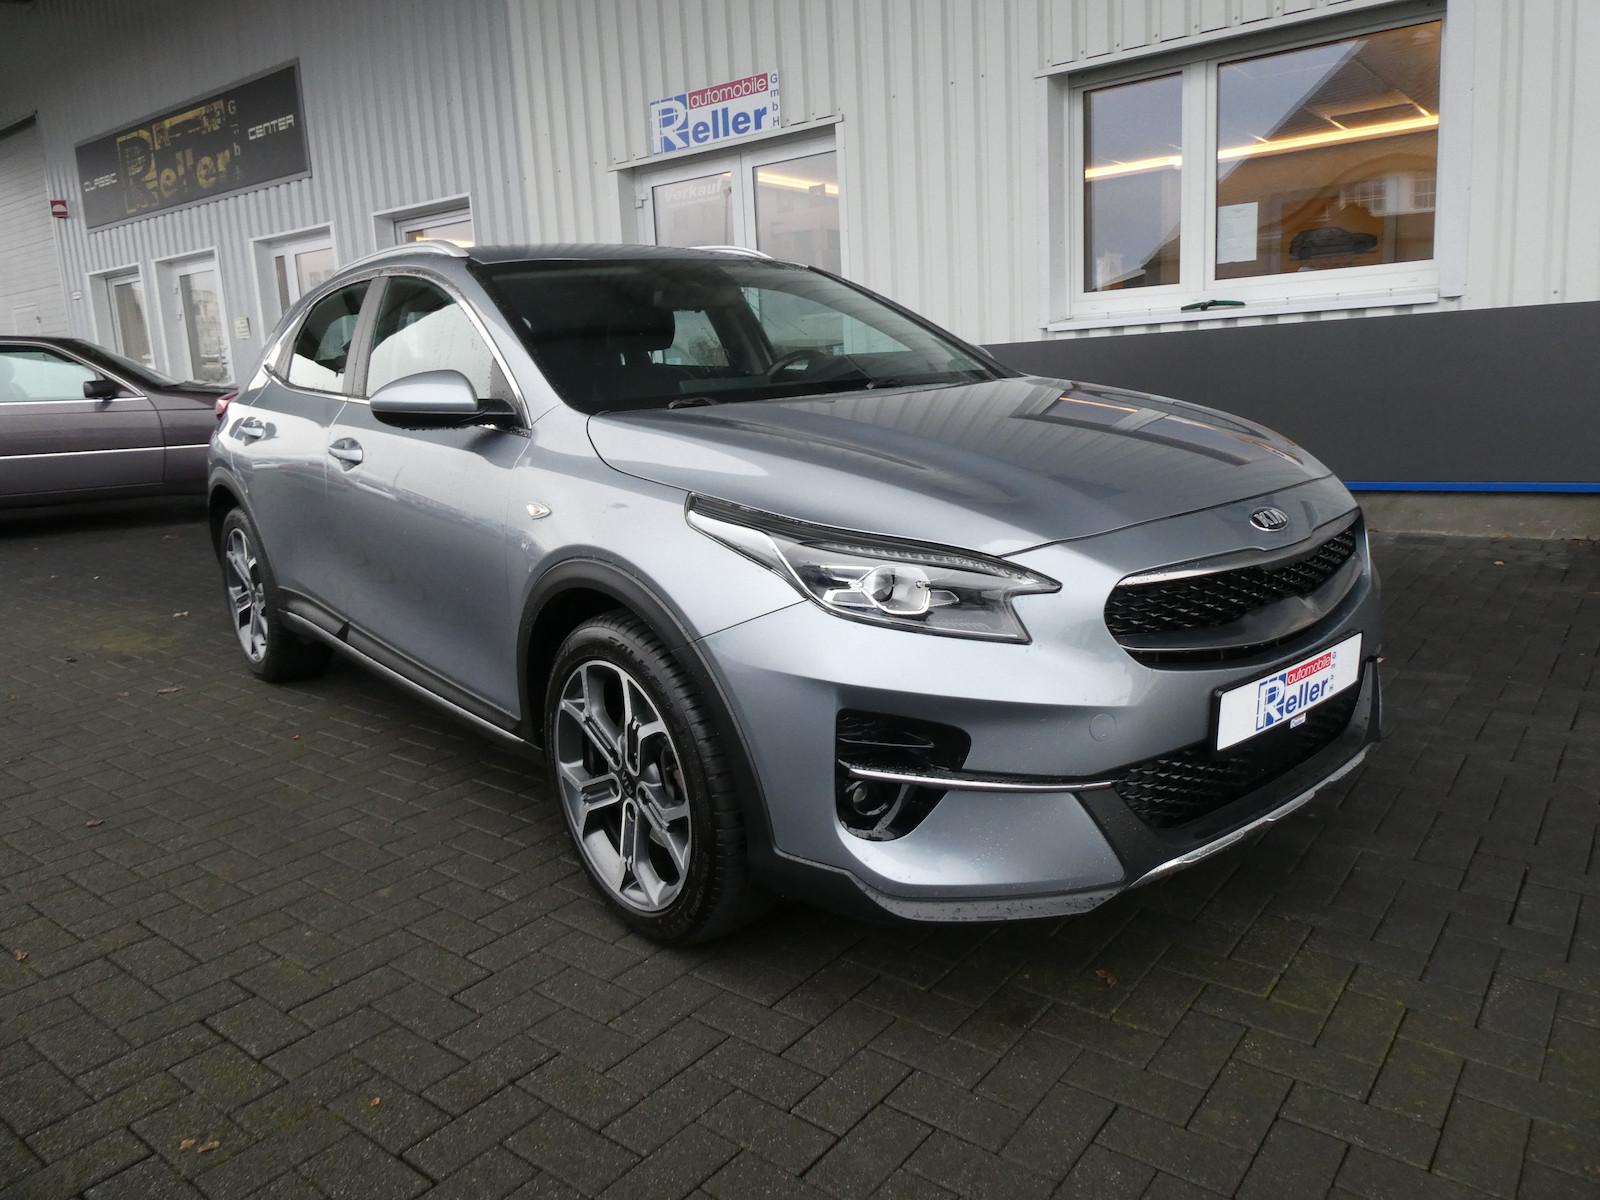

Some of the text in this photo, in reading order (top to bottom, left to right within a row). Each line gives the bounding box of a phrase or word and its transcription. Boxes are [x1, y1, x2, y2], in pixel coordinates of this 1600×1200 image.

[690, 76, 767, 108] automobile
[247, 114, 295, 140] CENTER
[650, 98, 768, 154] Reller
[1253, 510, 1287, 527] KIA
[1287, 654, 1332, 685] automobile
[1256, 675, 1329, 731] Reller
